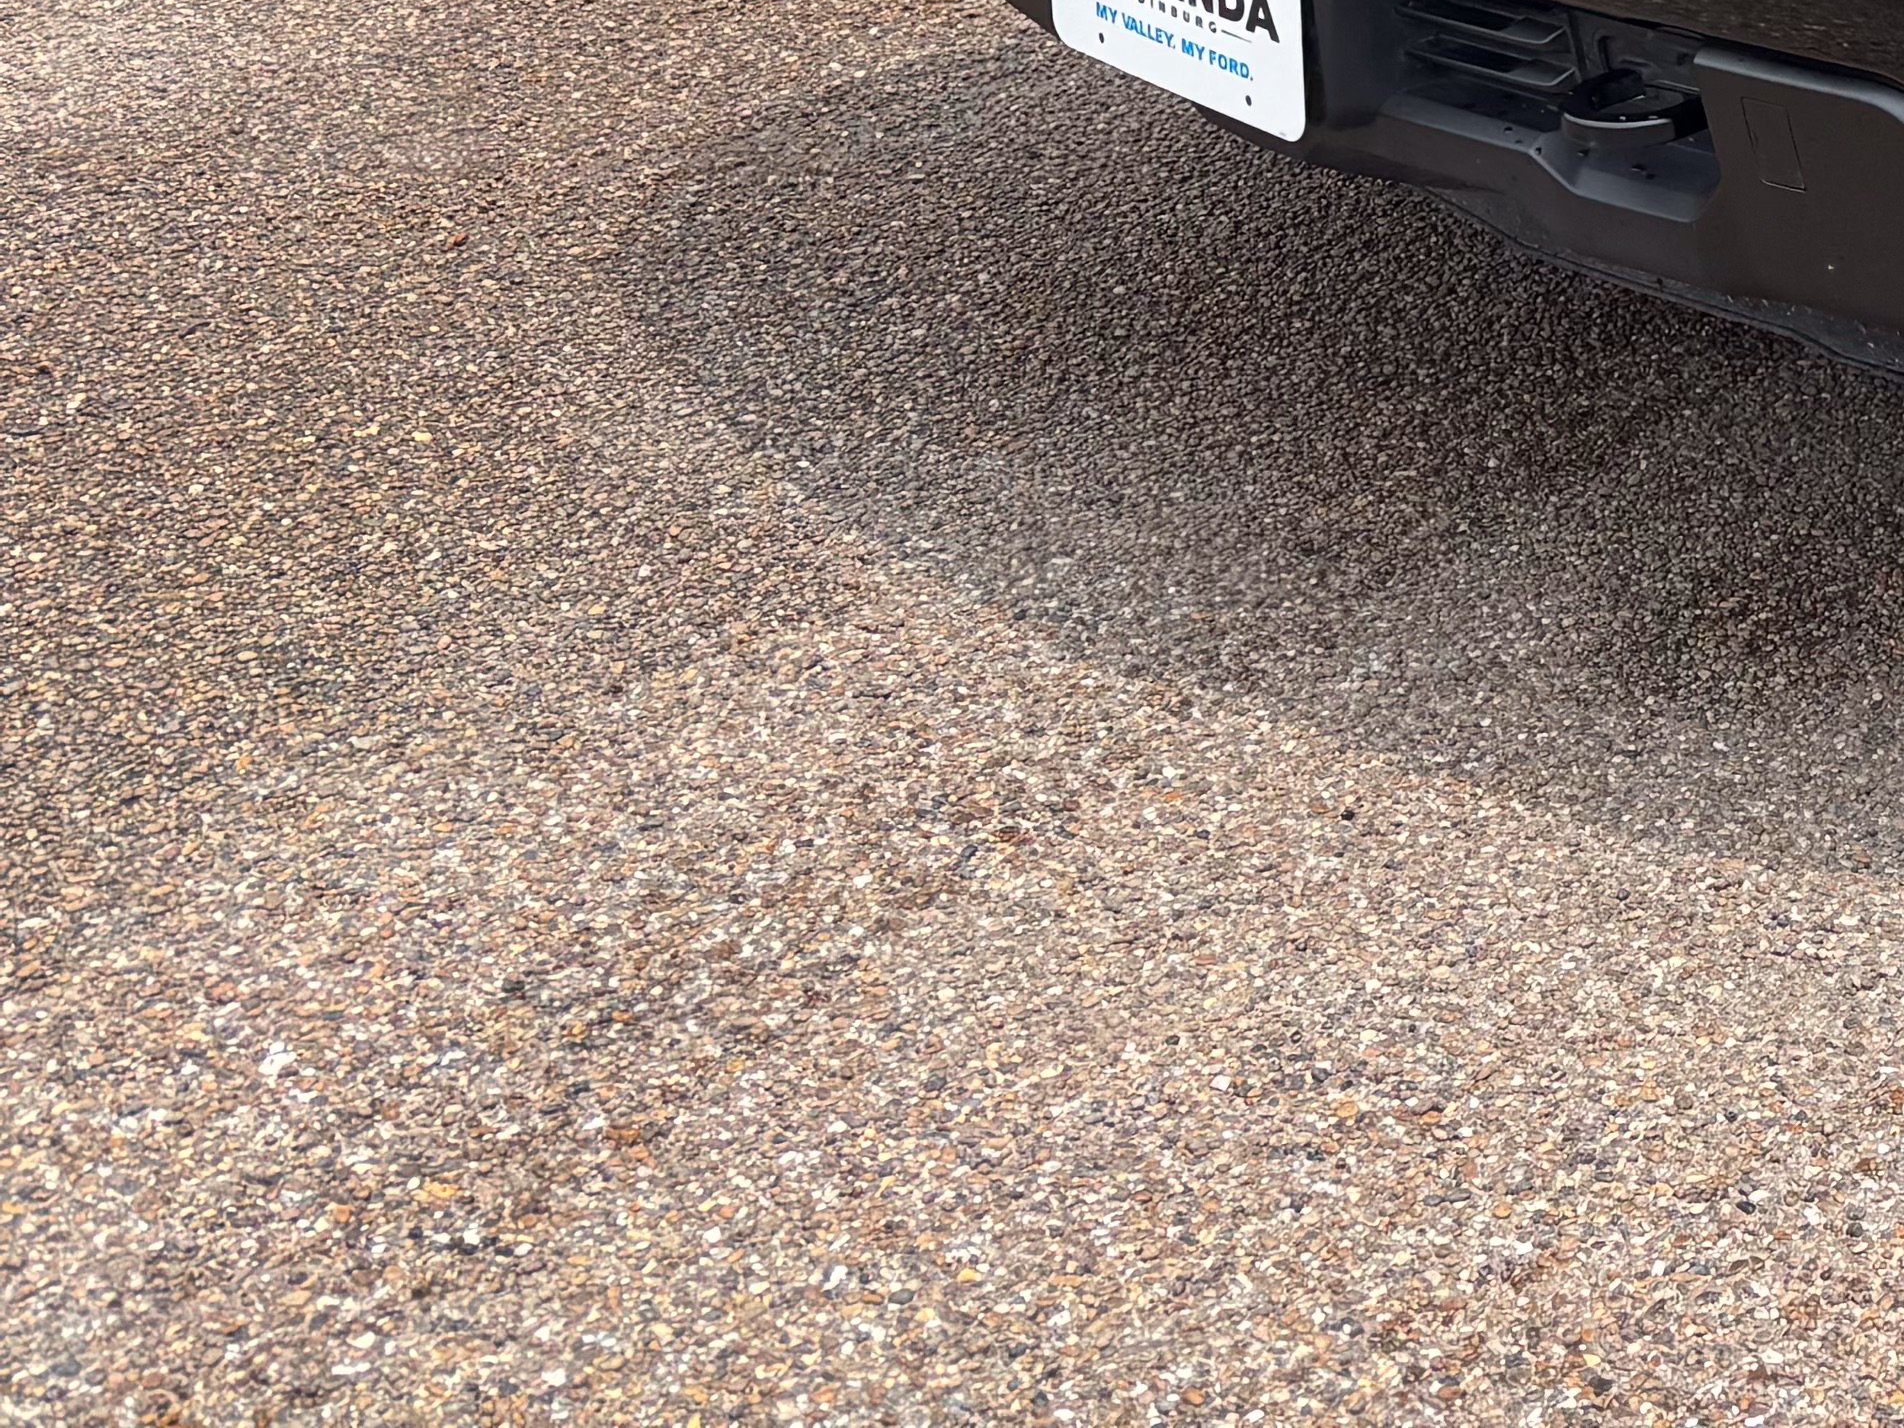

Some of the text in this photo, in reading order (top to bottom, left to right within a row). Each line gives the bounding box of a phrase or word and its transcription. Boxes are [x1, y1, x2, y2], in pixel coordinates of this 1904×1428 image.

[1095, 1, 1117, 24] MY
[1181, 37, 1205, 62] MY
[1209, 49, 1254, 81] FORD.
